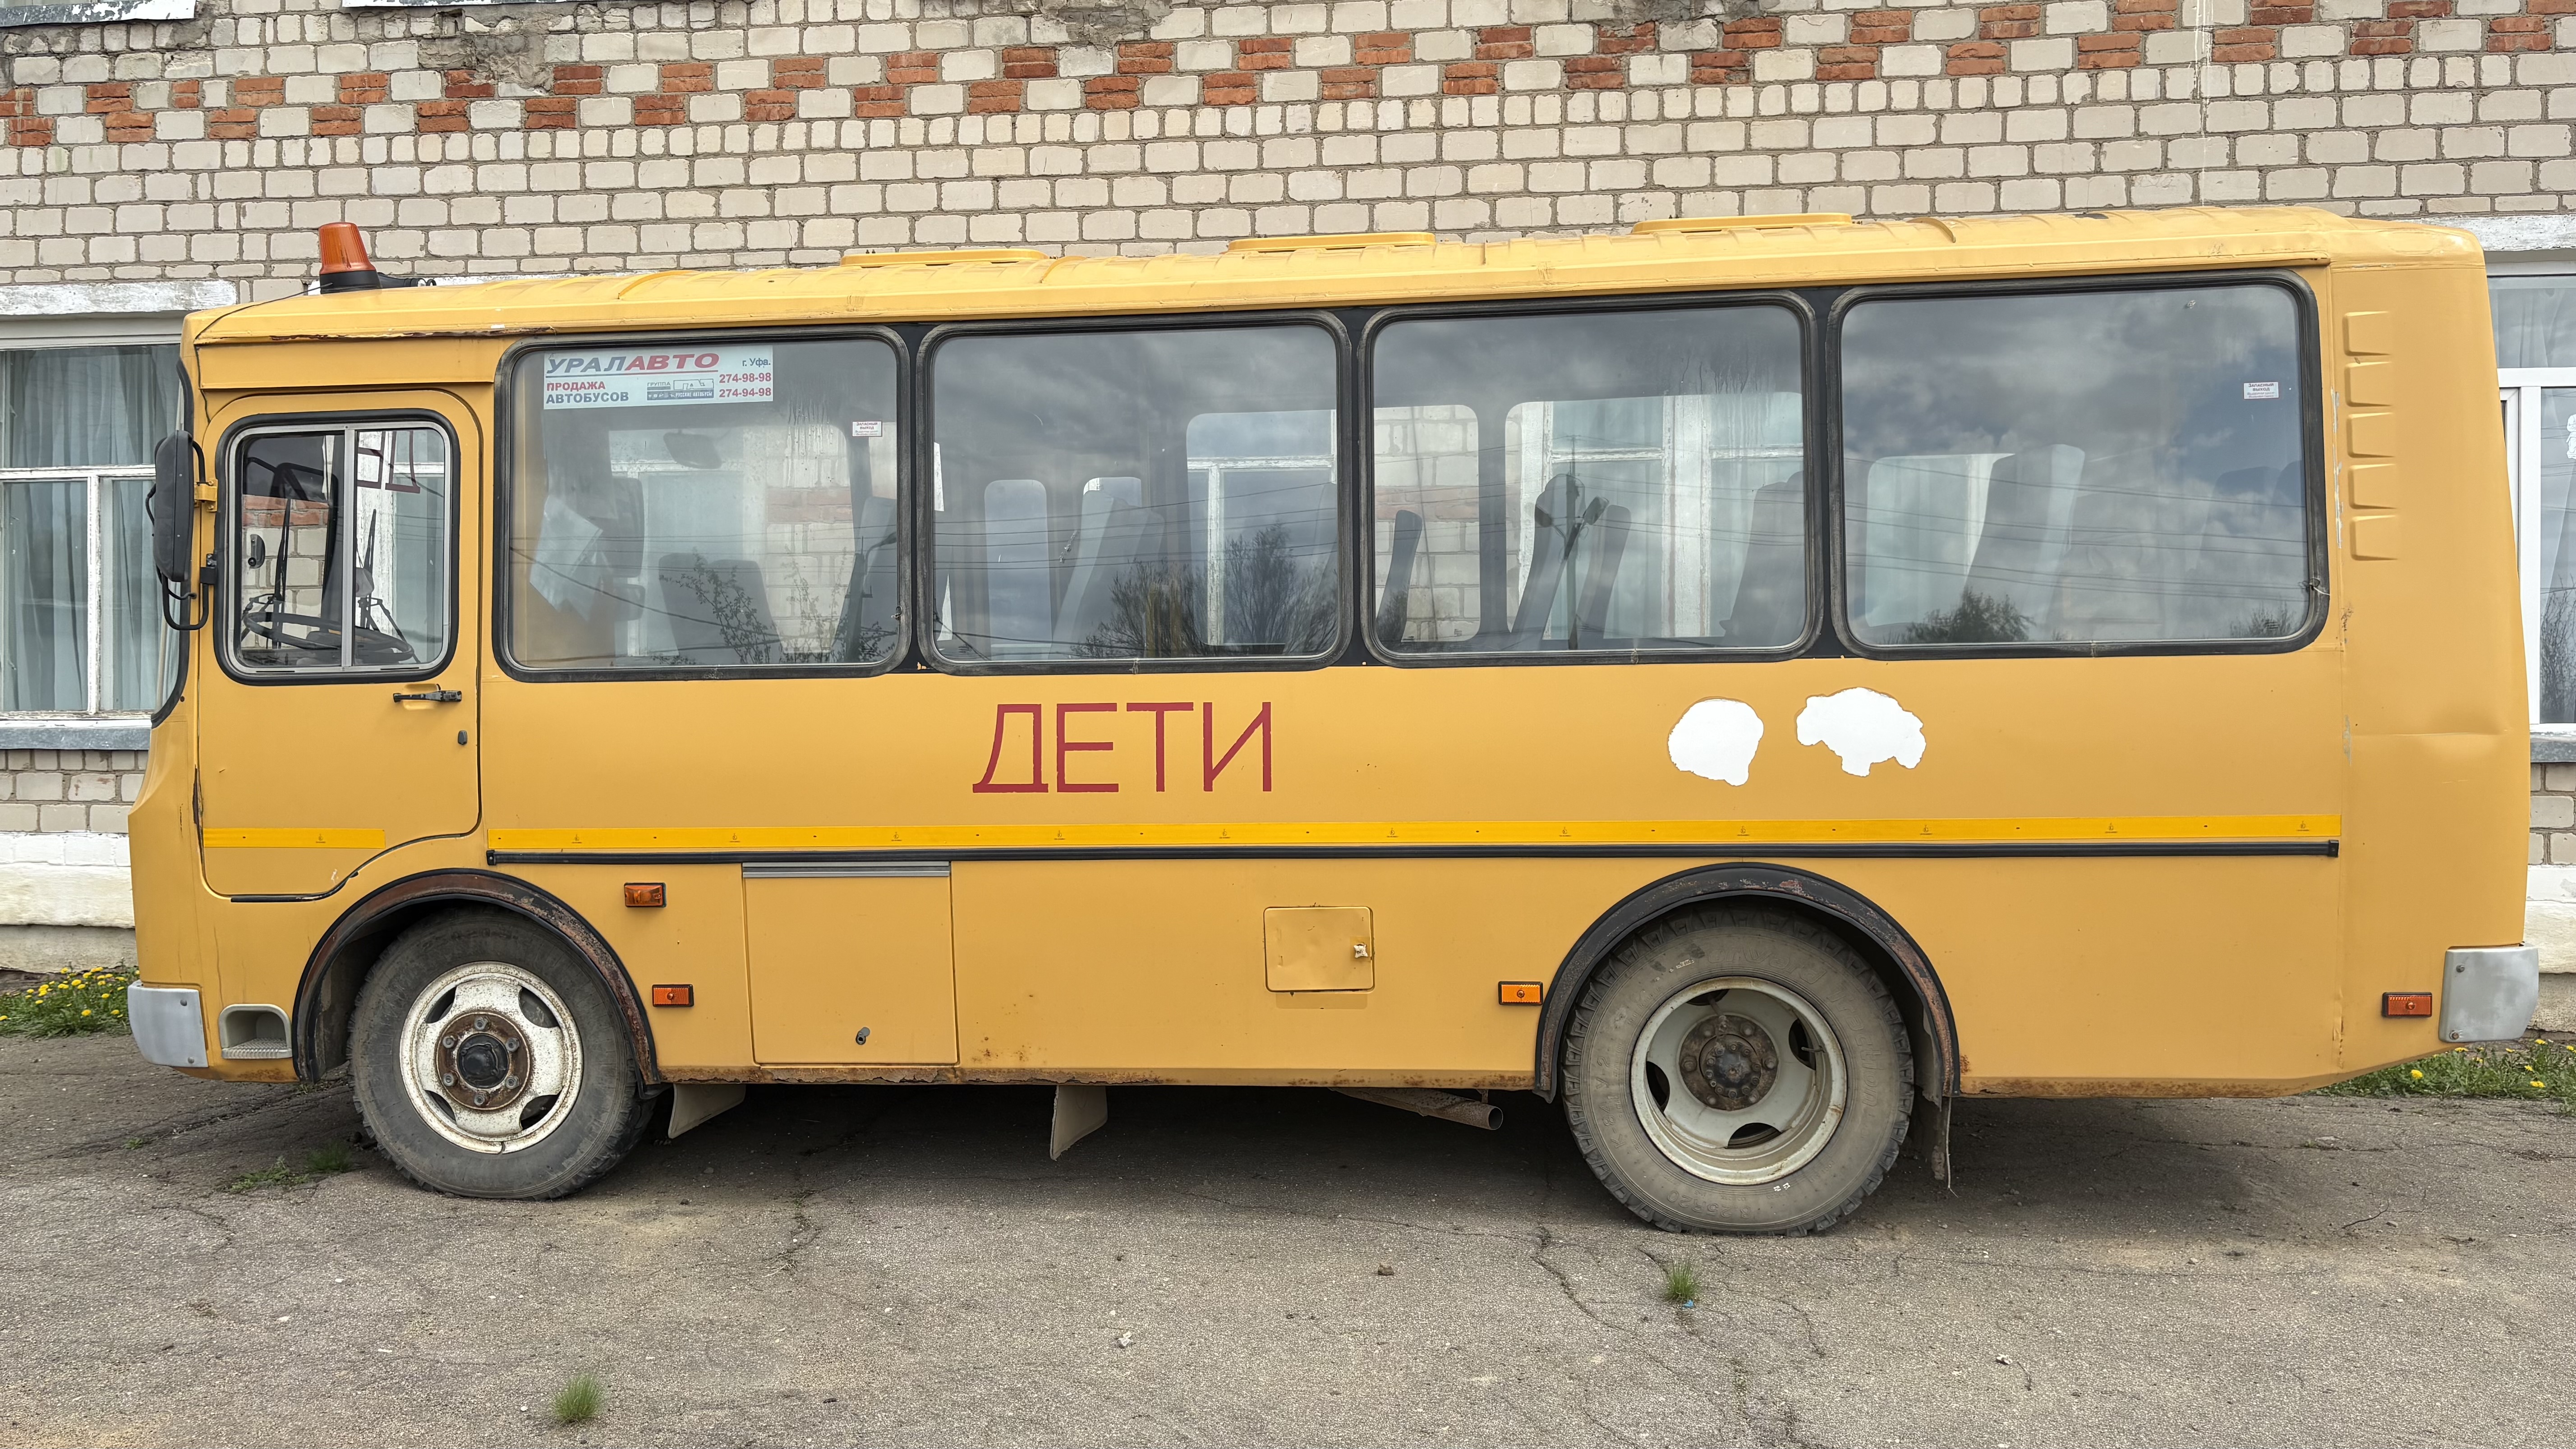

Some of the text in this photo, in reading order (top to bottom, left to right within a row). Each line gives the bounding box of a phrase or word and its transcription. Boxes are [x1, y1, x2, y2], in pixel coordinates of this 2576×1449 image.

[547, 353, 719, 373] УРАЛАВТО
[719, 373, 771, 383] 274-98-98
[547, 381, 606, 391] ПРОДАЖА
[546, 391, 629, 404] АВТОБУСОВ
[719, 387, 771, 398] 274-94-98
[972, 702, 1272, 793] ДЕТИ
